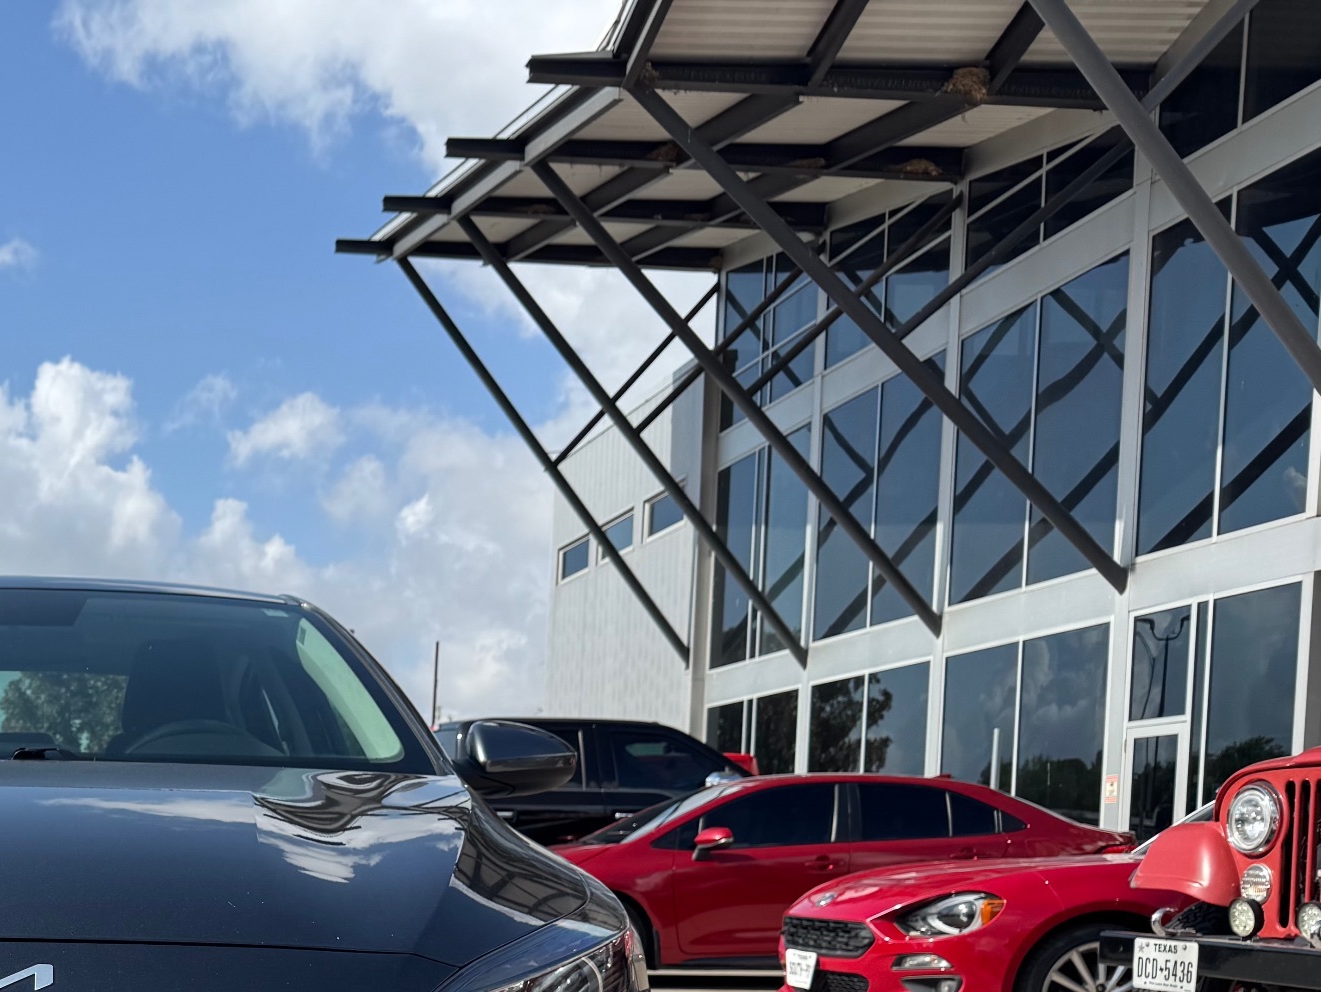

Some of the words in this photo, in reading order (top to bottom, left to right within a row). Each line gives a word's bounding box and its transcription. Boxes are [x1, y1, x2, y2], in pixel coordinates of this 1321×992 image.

[1154, 943, 1178, 954] TEXAS
[1137, 956, 1158, 979] DCD
[1164, 959, 1194, 984] 5436
